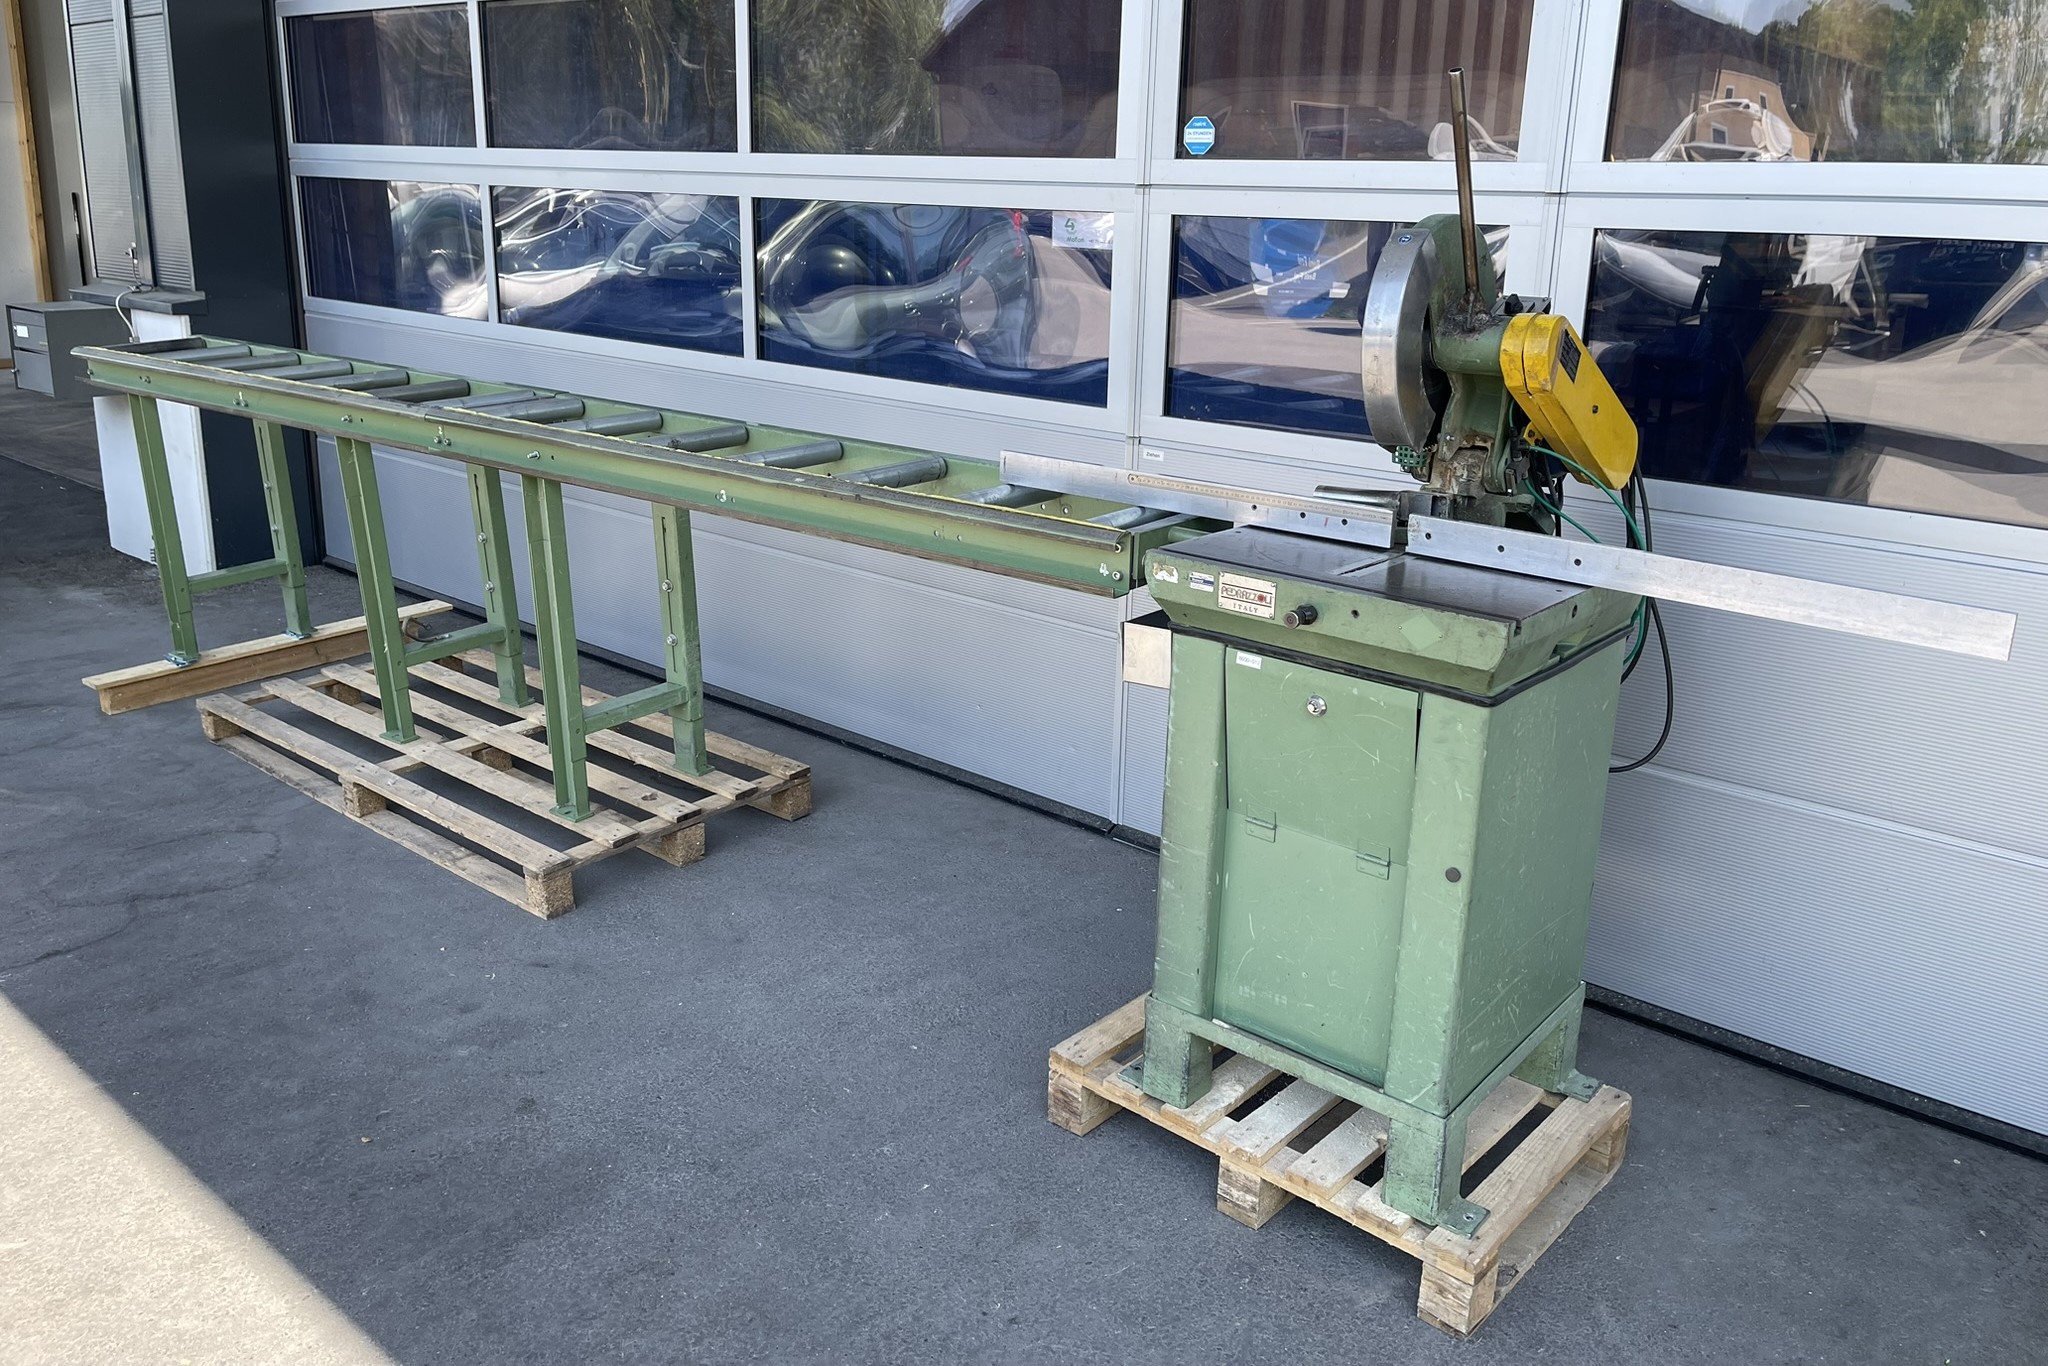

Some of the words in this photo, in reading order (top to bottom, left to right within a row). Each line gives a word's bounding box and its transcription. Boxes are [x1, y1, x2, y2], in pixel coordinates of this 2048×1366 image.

[1099, 562, 1110, 577] 4
[1220, 585, 1273, 605] PEDRAZZOLI
[1233, 602, 1259, 613] ITALY
